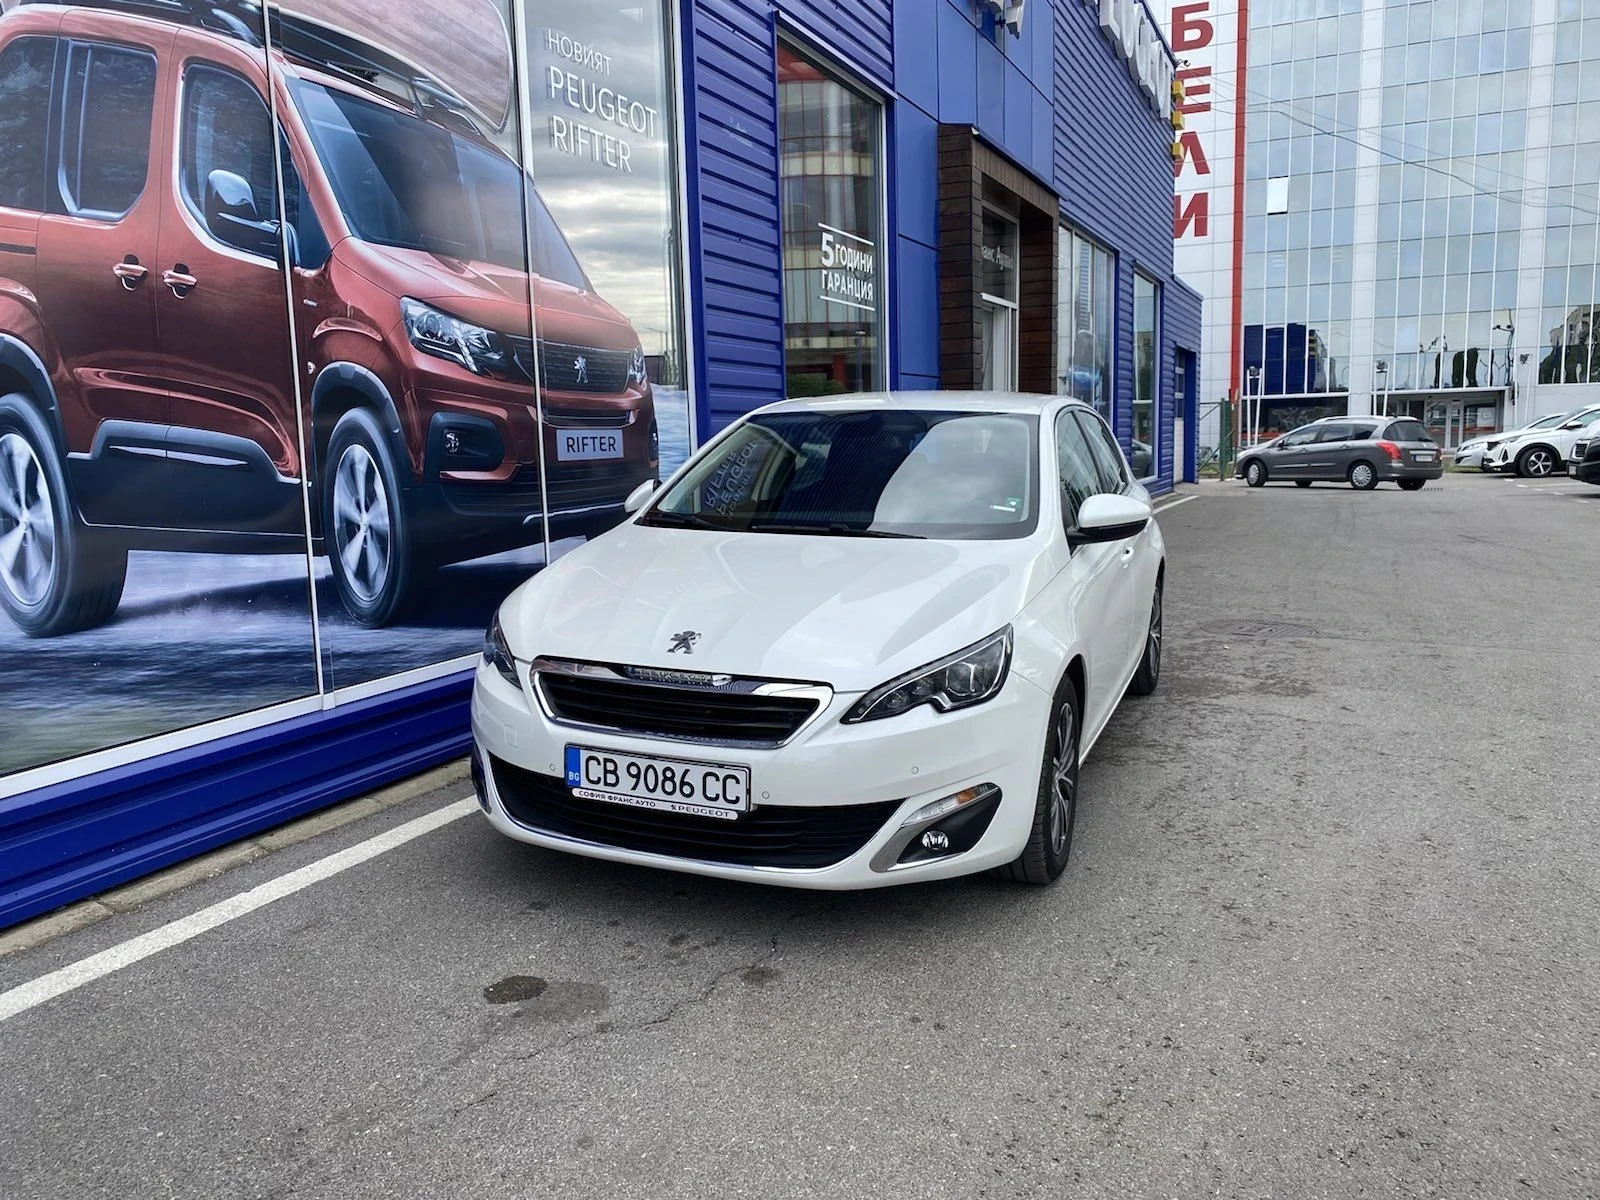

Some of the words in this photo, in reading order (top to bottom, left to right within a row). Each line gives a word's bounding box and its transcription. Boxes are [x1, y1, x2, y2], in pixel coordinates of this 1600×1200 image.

[546, 29, 612, 76] НОВИЯТ
[1081, 0, 1175, 119] UGEOT
[549, 65, 658, 138] PEUGEOT
[1171, 2, 1214, 239] БЕЛИ
[551, 115, 633, 173] RIFTER
[821, 232, 834, 268] 5
[835, 243, 873, 274] ГОДИНИ
[821, 269, 874, 301] ГАРАНЦИЯ
[566, 436, 617, 454] RIFTER
[568, 771, 580, 782] BG
[585, 755, 620, 788] CB
[626, 761, 695, 799] 9086
[702, 771, 741, 805] CC
[578, 790, 606, 799] СОФИЯ
[607, 795, 635, 804] ФРАНС
[635, 799, 656, 808] АУТО
[678, 805, 730, 818] PEUGEOT
